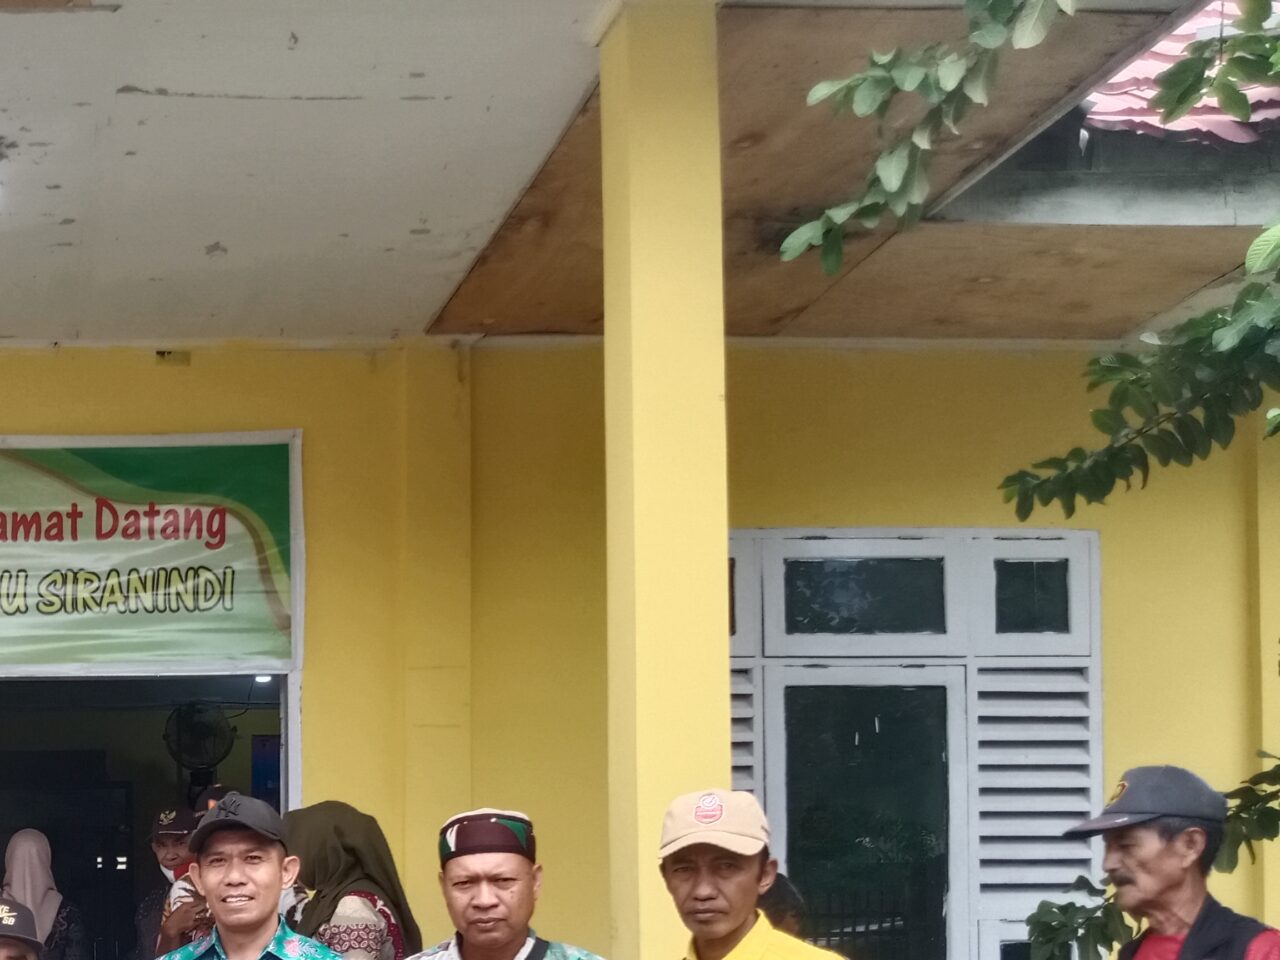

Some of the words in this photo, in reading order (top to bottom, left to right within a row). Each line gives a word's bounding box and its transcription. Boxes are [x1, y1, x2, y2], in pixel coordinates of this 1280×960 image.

[95, 497, 227, 550] Datang
[36, 566, 235, 615] SIRANINDI
[1, 916, 16, 925] SB
